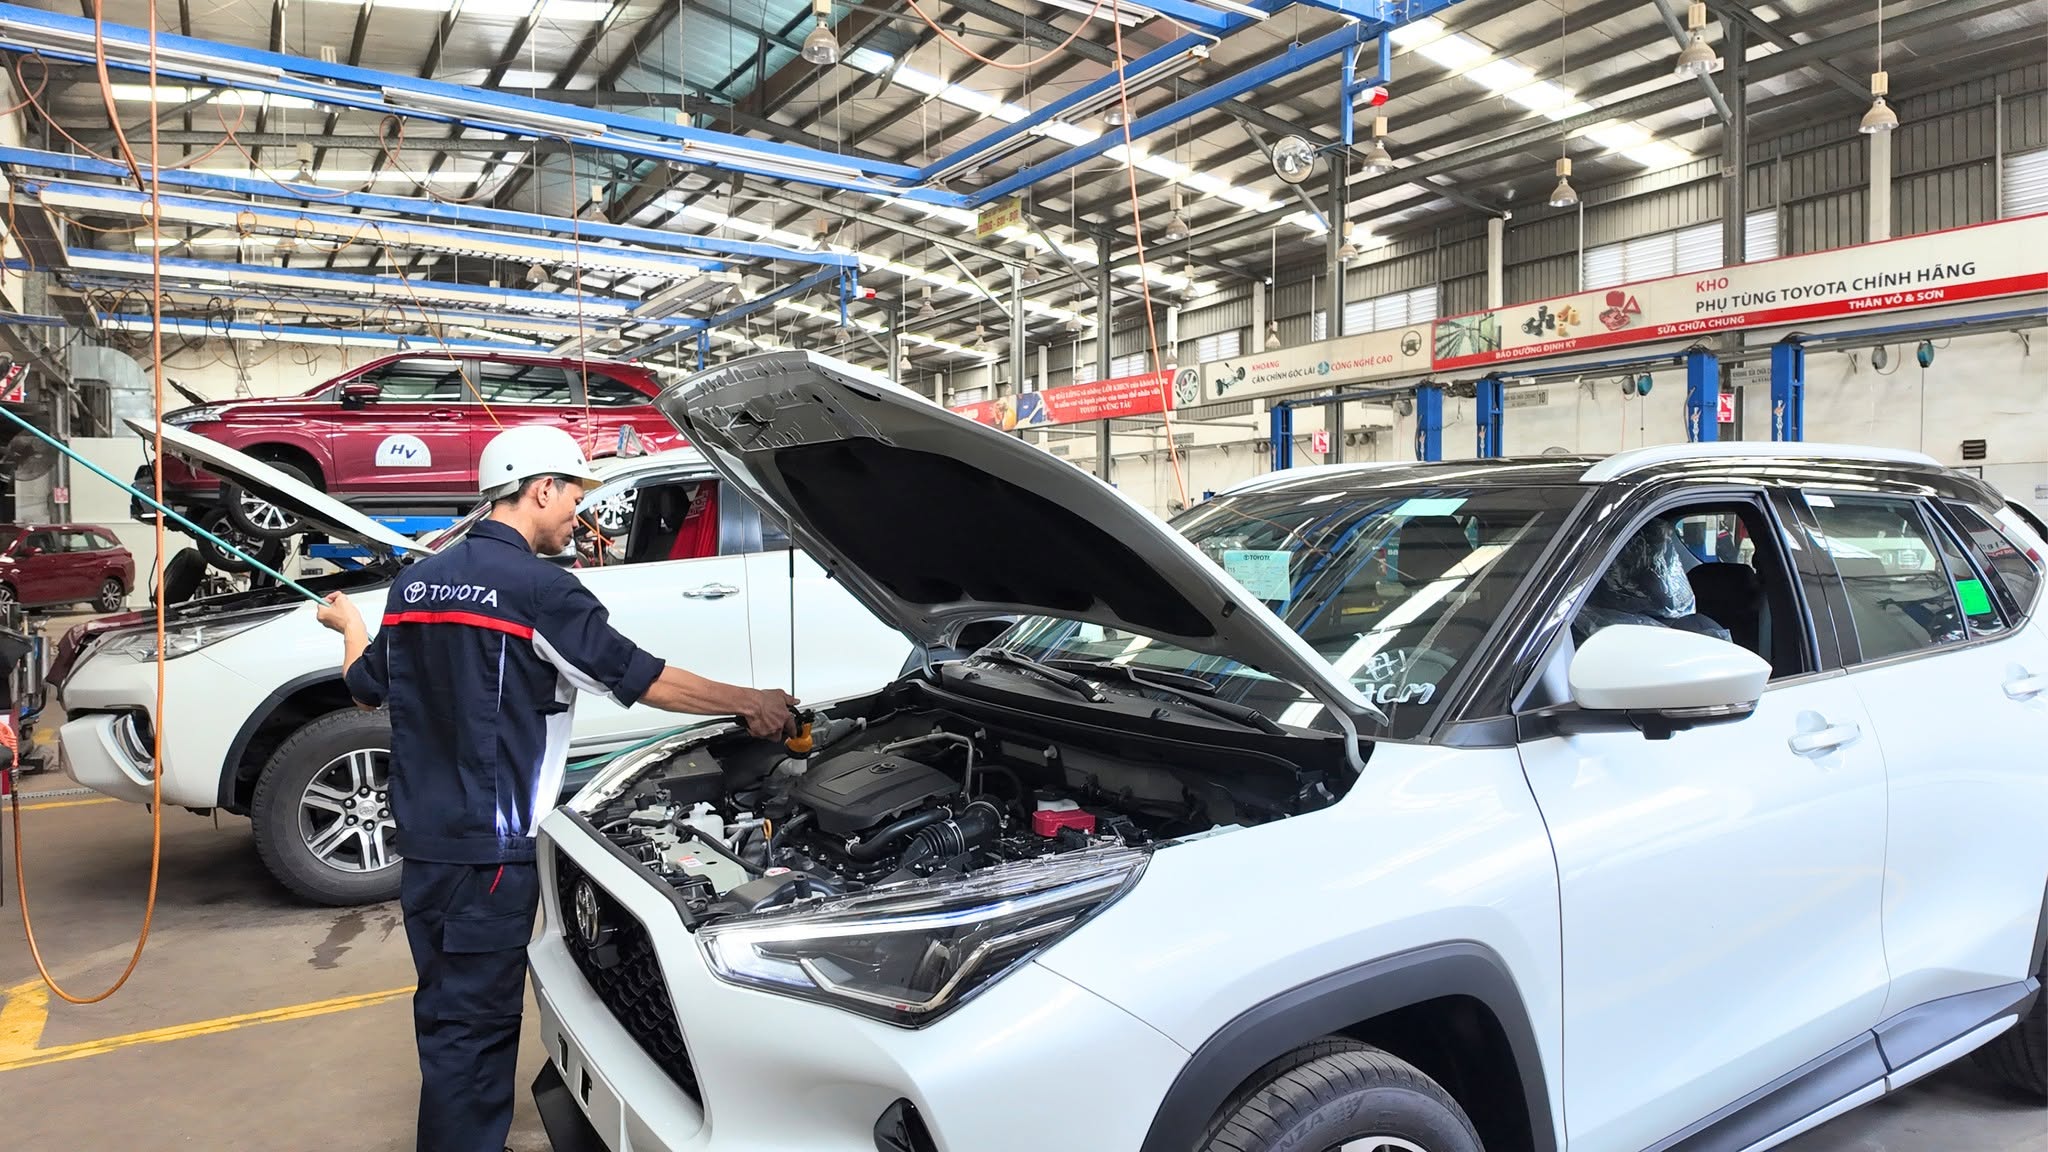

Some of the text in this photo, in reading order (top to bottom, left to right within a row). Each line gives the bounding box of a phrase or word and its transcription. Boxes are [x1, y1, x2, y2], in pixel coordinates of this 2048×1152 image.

[1696, 277, 1728, 293] KHO
[1696, 262, 1976, 313] PHỤ TÙNG TOYOTA CHÍNH HÃNG
[1848, 297, 1882, 310] THÂN
[1905, 294, 1914, 302] &
[1917, 290, 1944, 301] SƠN
[1708, 316, 1745, 328] CHUNG
[1376, 354, 1393, 364] CAO
[430, 584, 498, 608] TOYOTA
